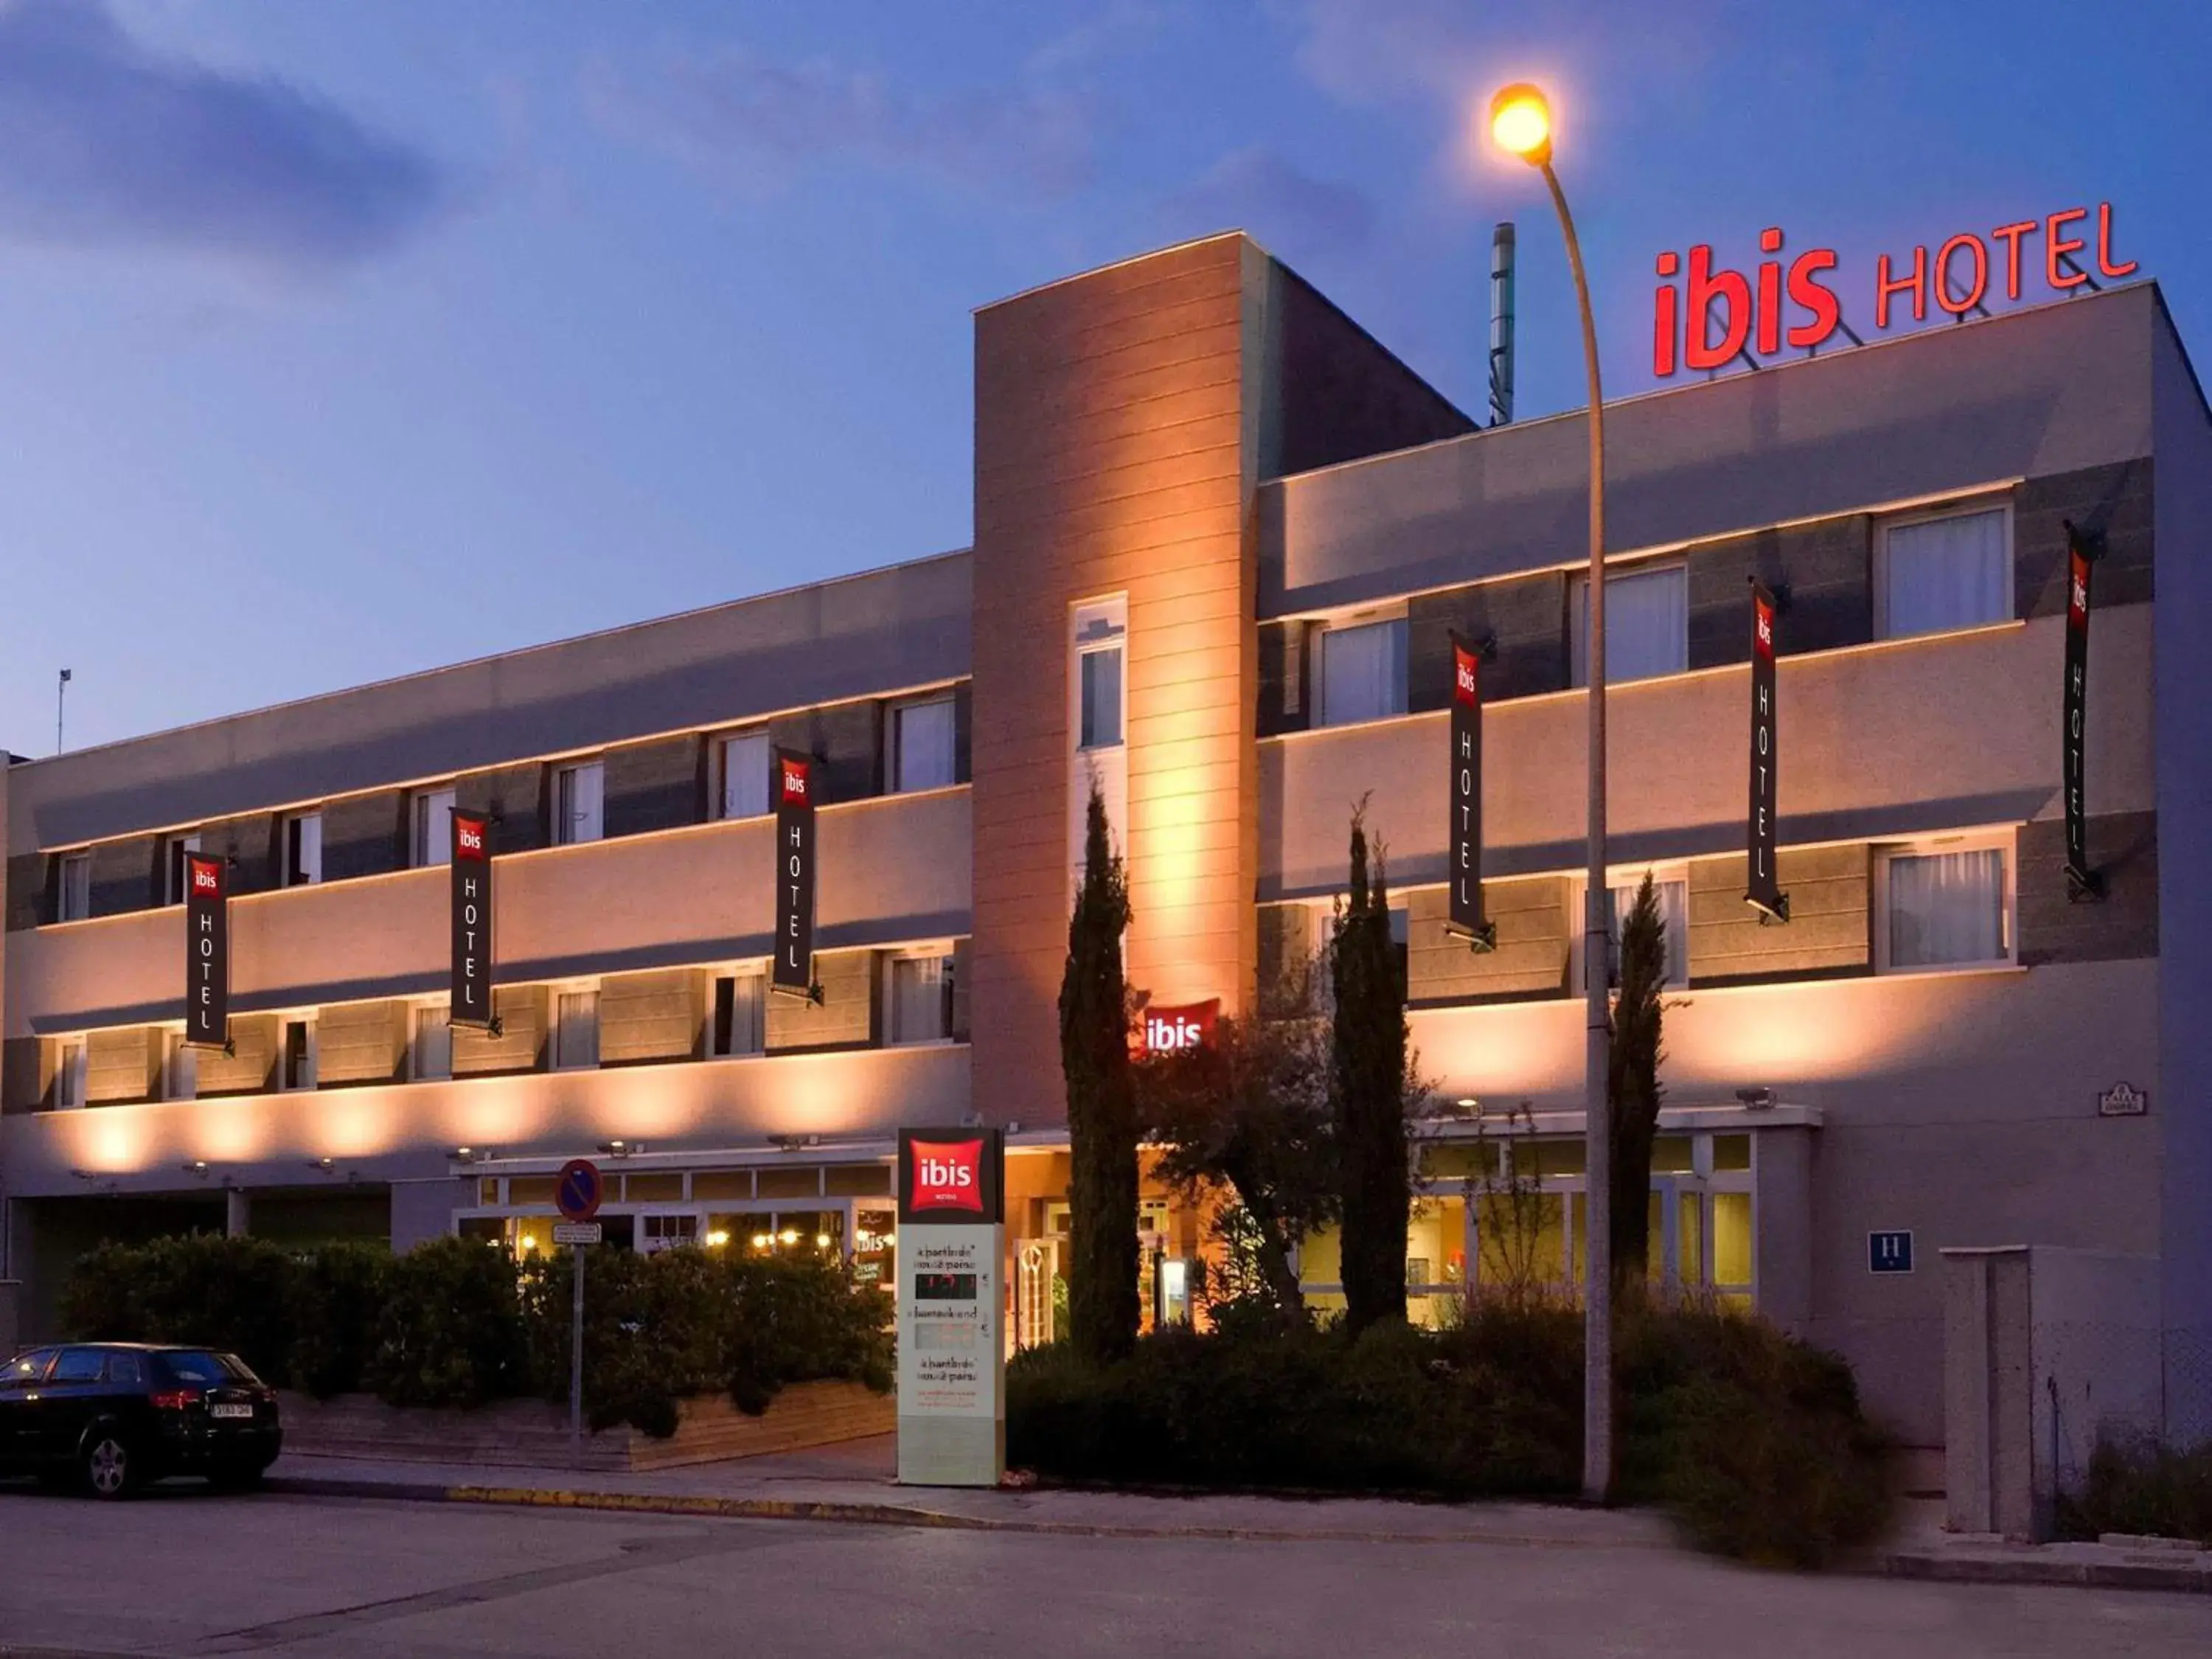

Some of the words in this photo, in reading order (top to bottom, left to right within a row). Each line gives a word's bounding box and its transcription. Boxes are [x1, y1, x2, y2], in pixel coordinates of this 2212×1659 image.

[1654, 226, 1839, 377] ibis
[1877, 201, 2137, 328] HOTEL
[1457, 663, 1475, 693] ibis
[785, 771, 804, 793] ibis
[1758, 684, 1768, 878] HOTEL
[2070, 663, 2081, 851] HOTEL
[459, 829, 481, 849] ibis
[1461, 731, 1471, 905] HOTEL
[195, 870, 216, 888] ibis
[789, 826, 800, 968] HOTEL
[201, 913, 212, 1029] HOTEL
[465, 877, 477, 1004] HOTEL
[1147, 1016, 1202, 1051] ibis
[920, 1158, 972, 1187] ibis
[1882, 1236, 1900, 1258] H
